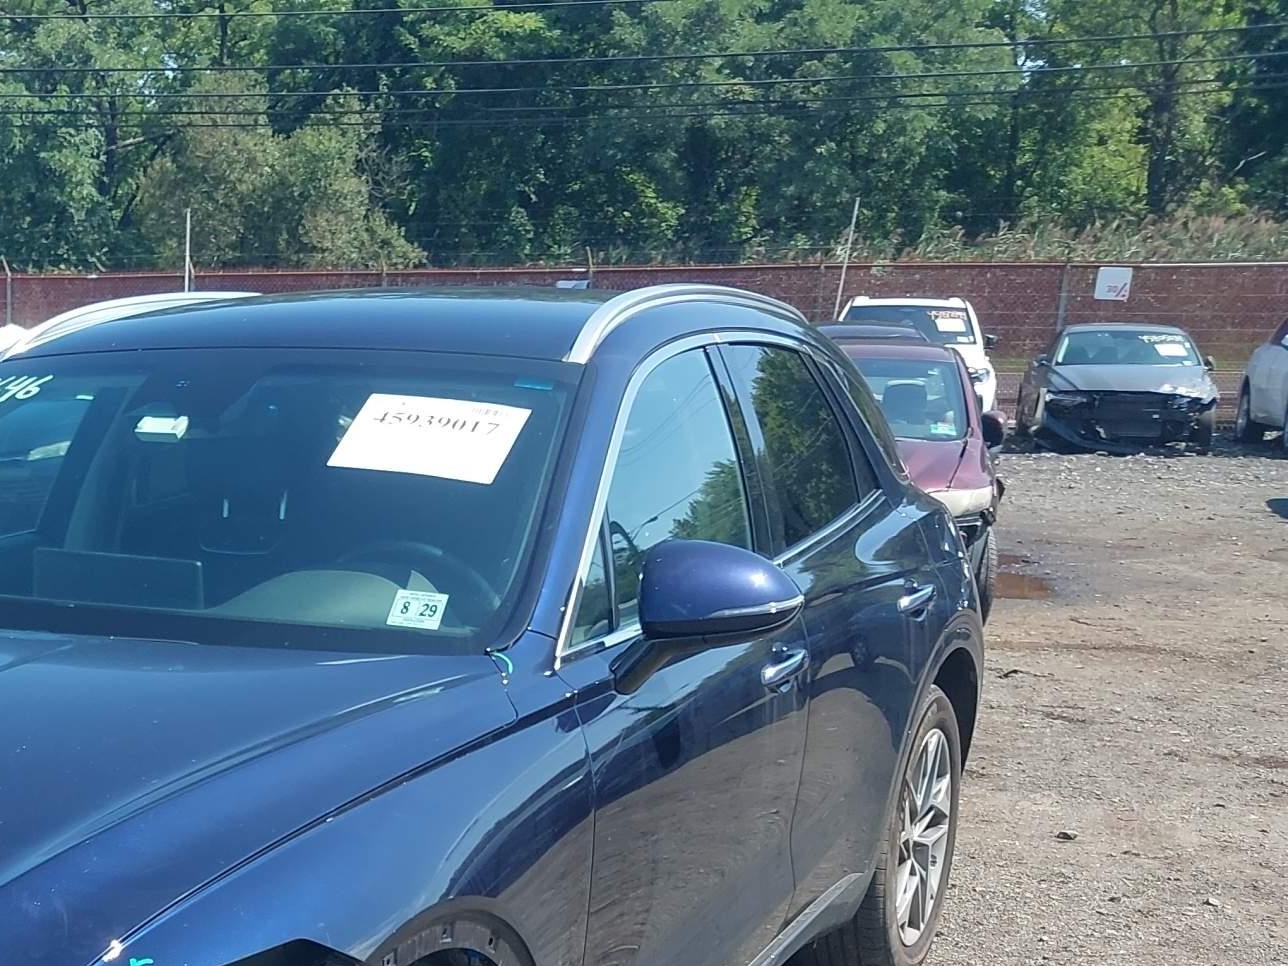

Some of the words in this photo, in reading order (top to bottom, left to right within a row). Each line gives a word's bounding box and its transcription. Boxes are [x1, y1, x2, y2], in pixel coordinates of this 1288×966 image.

[373, 410, 501, 434] 45939017
[400, 601, 411, 615] 8
[418, 603, 438, 618] 29
